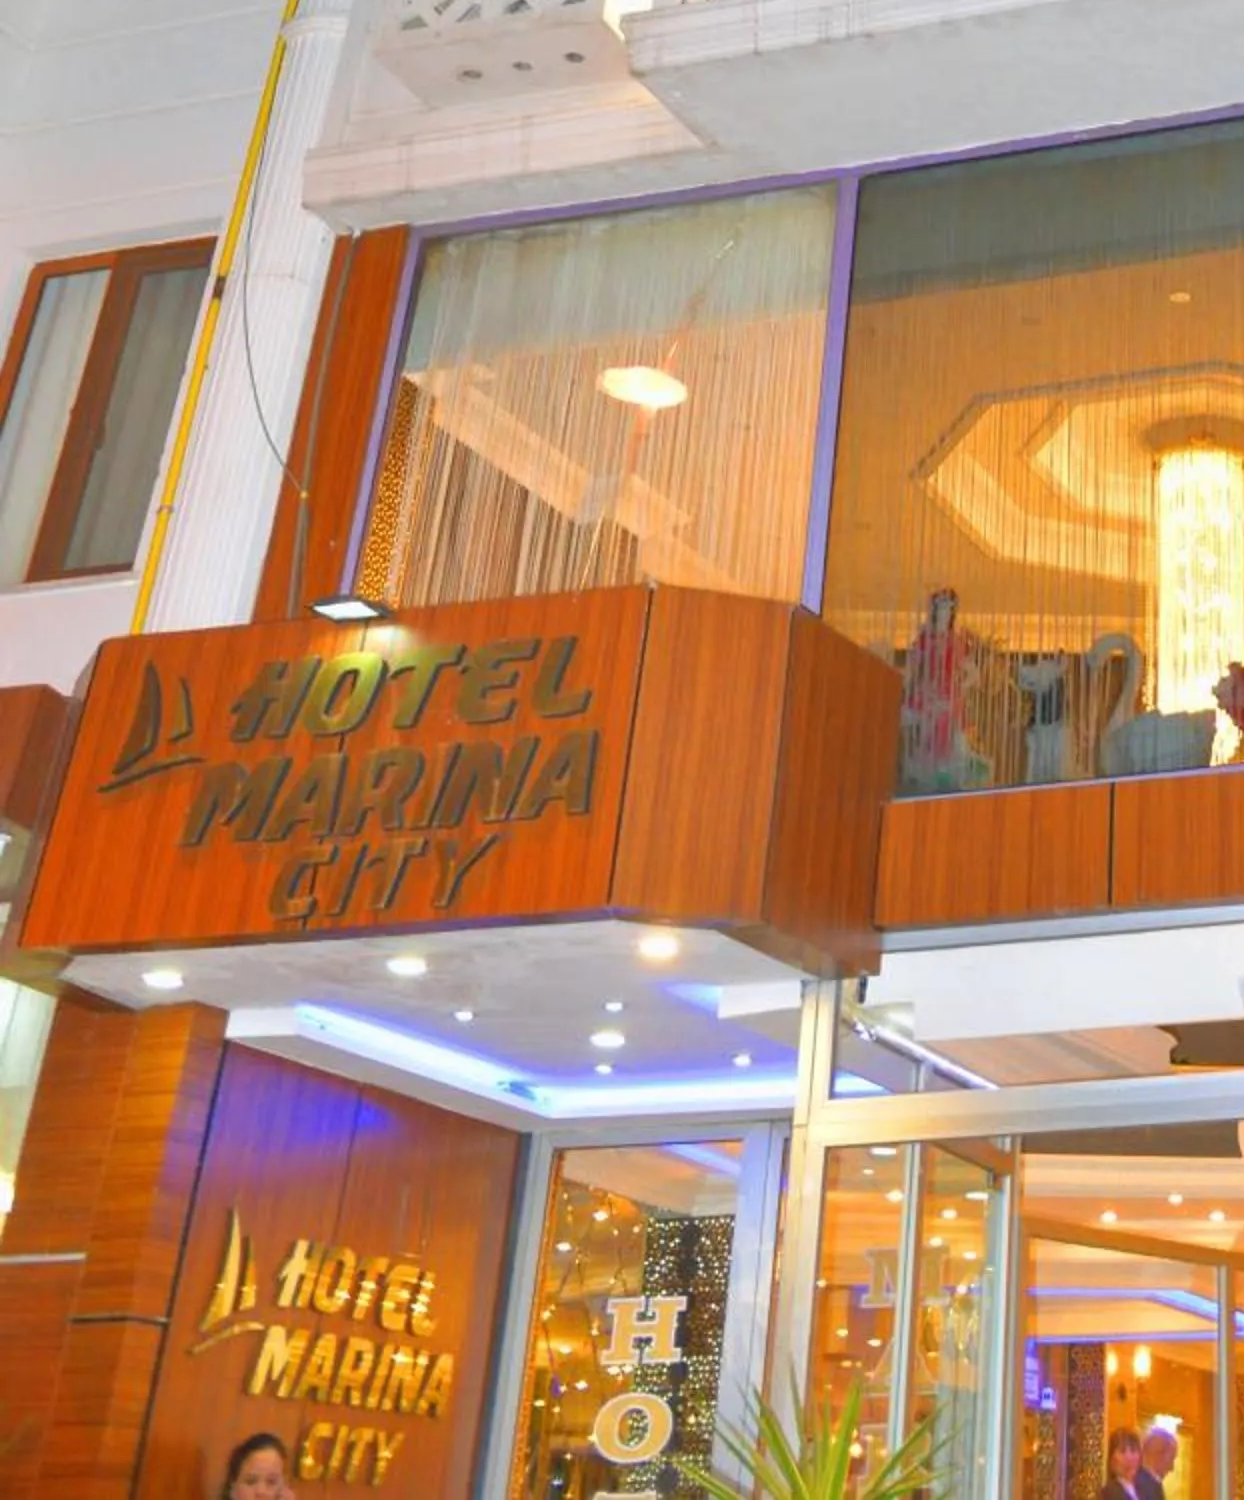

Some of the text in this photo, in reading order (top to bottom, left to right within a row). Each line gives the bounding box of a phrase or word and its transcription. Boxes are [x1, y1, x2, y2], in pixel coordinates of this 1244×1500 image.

[230, 636, 592, 742] HOTEL
[181, 729, 600, 848] MARINA
[267, 833, 499, 920] CITY
[276, 1238, 438, 1337] HOTEL
[248, 1324, 455, 1419] MARINA
[298, 1421, 405, 1488] CITY
